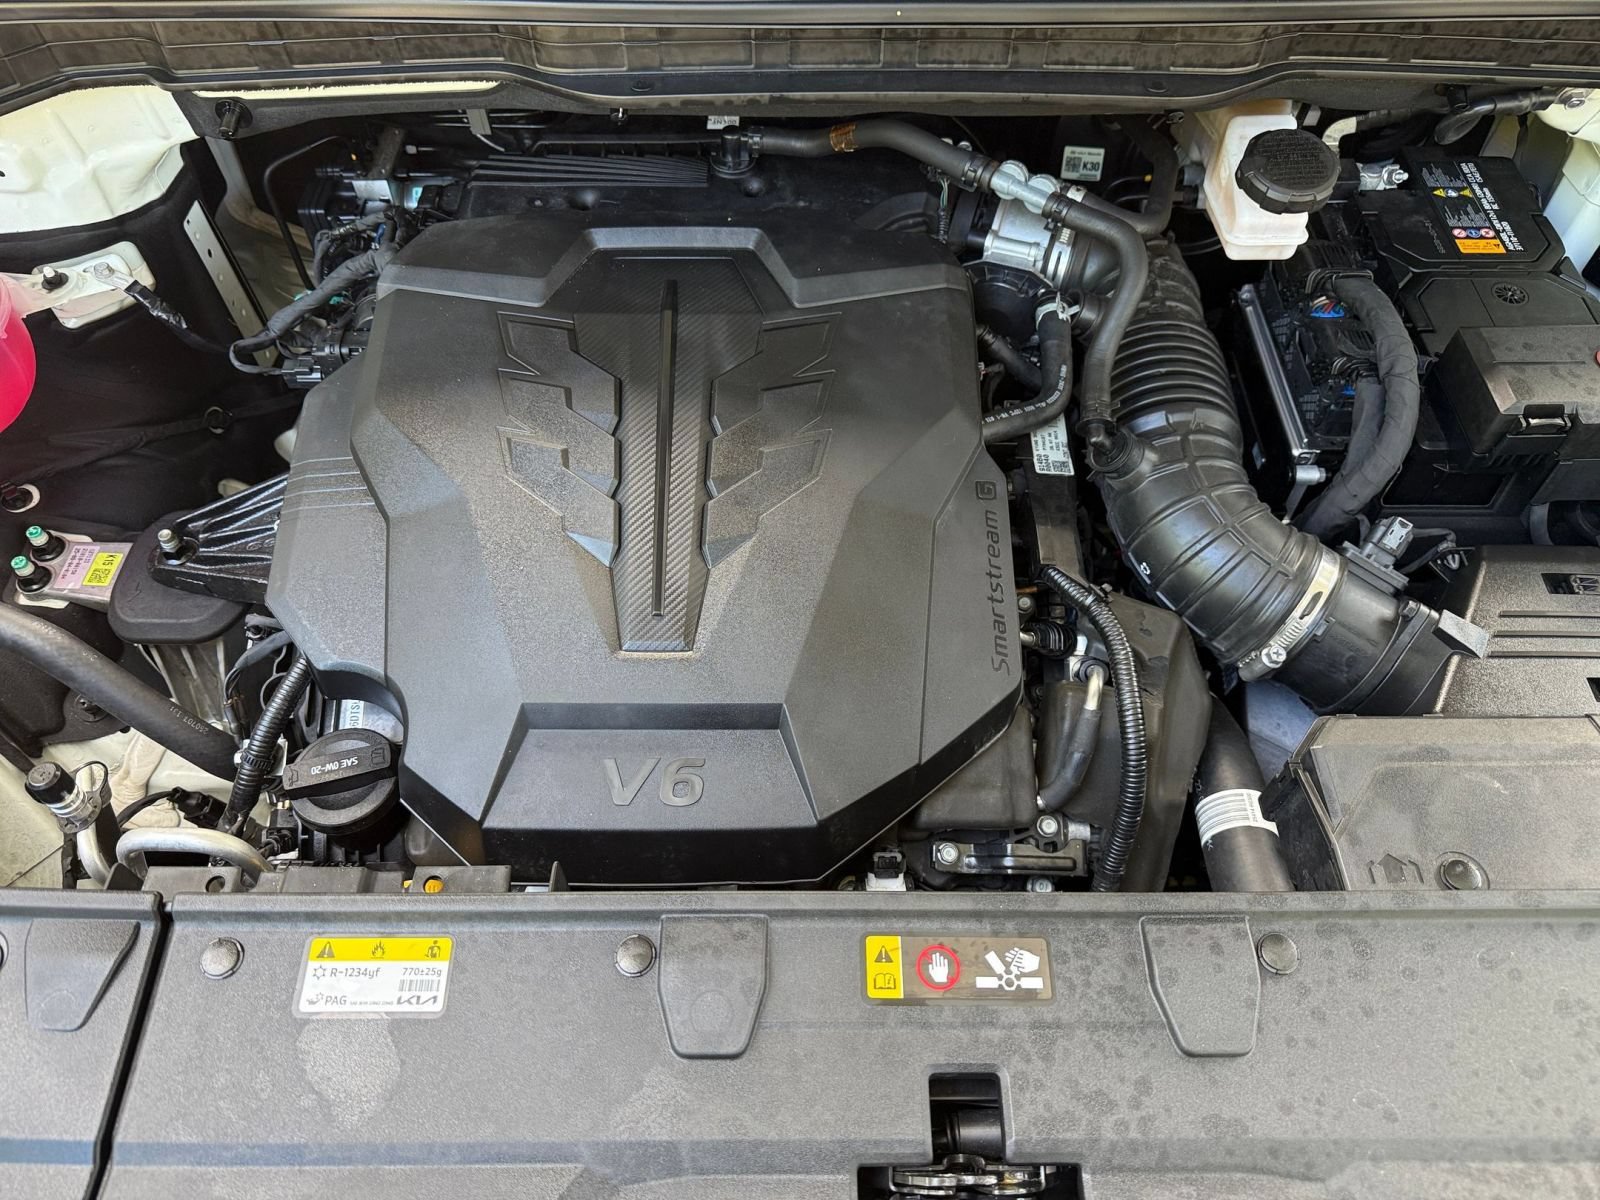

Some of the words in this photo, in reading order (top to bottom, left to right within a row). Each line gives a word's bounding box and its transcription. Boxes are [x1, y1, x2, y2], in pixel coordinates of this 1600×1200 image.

[1082, 160, 1100, 172] K30
[102, 554, 117, 566] K15
[985, 509, 1010, 677] Smartstream
[349, 700, 361, 728] 6DTS
[311, 761, 340, 775] 0W-20
[340, 756, 359, 768] SAE
[603, 756, 706, 807] V6
[330, 966, 381, 979] R-1234yf
[402, 967, 442, 977] 770±25g
[325, 995, 347, 1006] PAG
